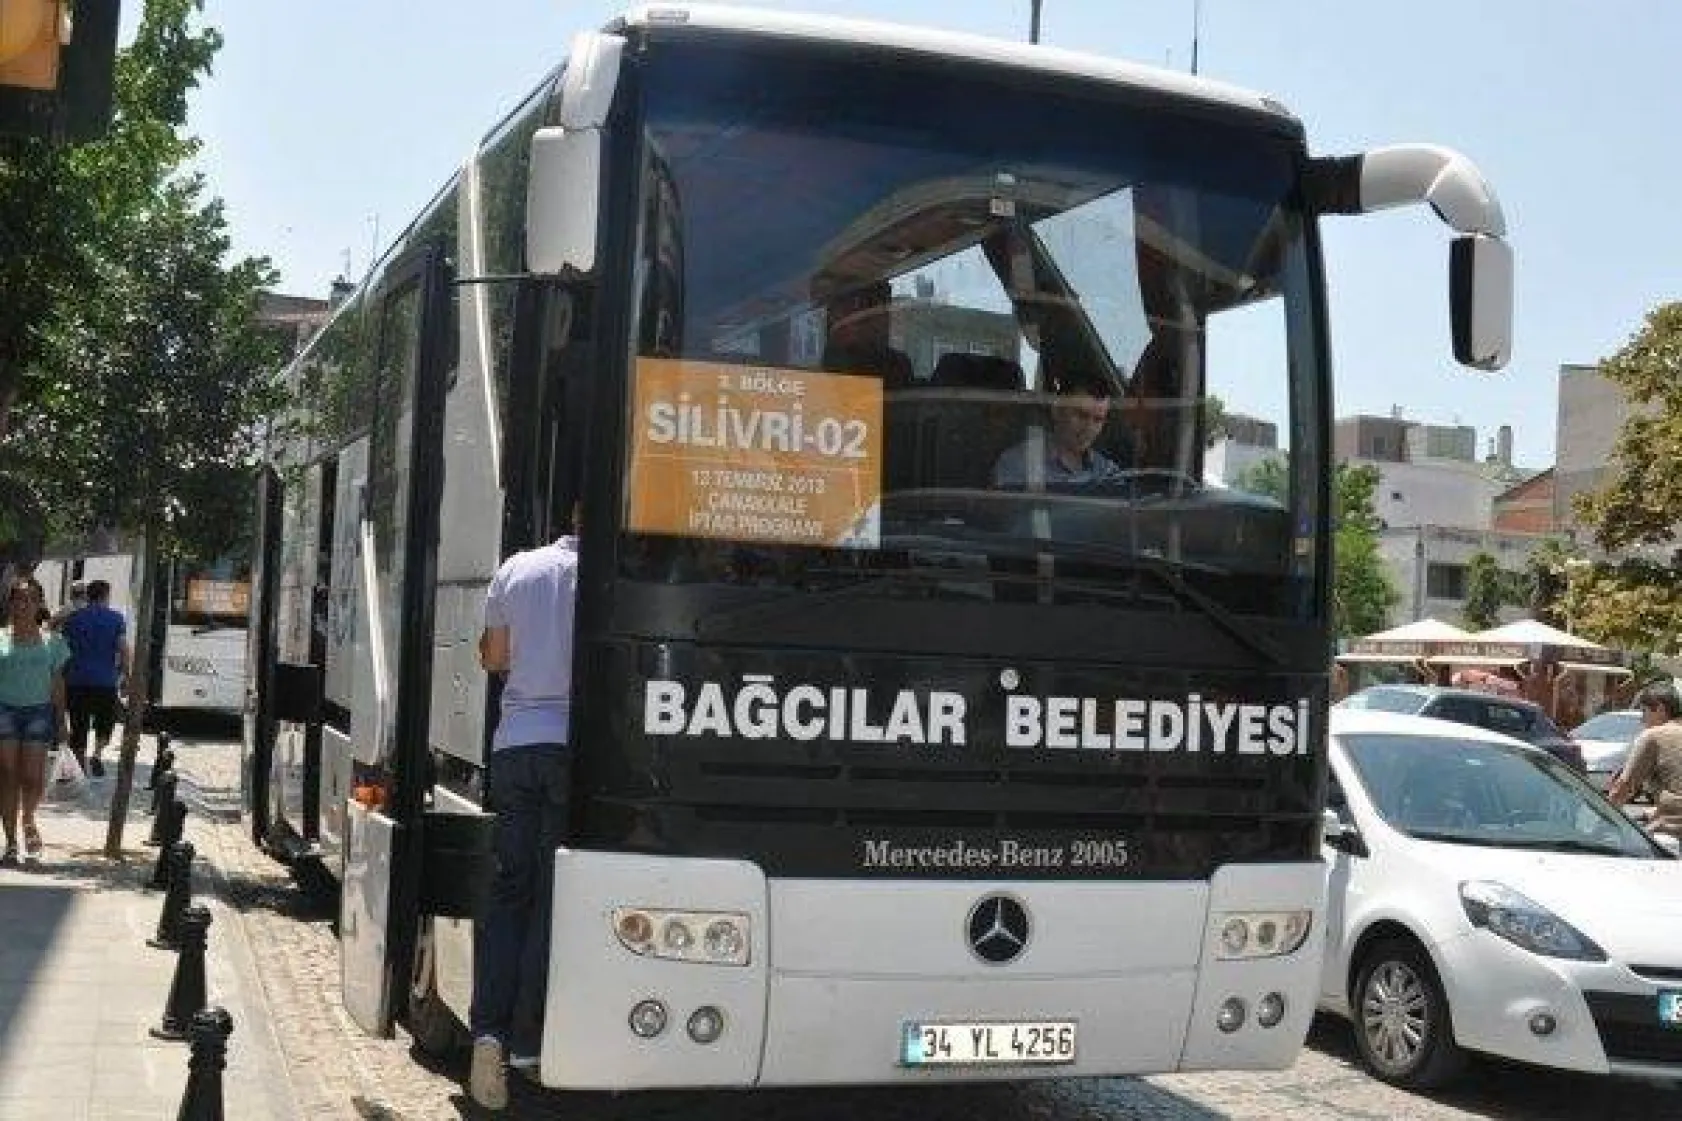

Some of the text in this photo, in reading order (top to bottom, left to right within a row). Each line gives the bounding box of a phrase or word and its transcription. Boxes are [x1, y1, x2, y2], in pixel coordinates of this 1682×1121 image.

[648, 391, 869, 458] SİLİVRİ-02
[644, 674, 1310, 755] BAĞCILAR BELEDİYESİ
[863, 839, 1129, 868] Mercedes-Benz 2005
[924, 1026, 1073, 1057] 34 YL 4256
